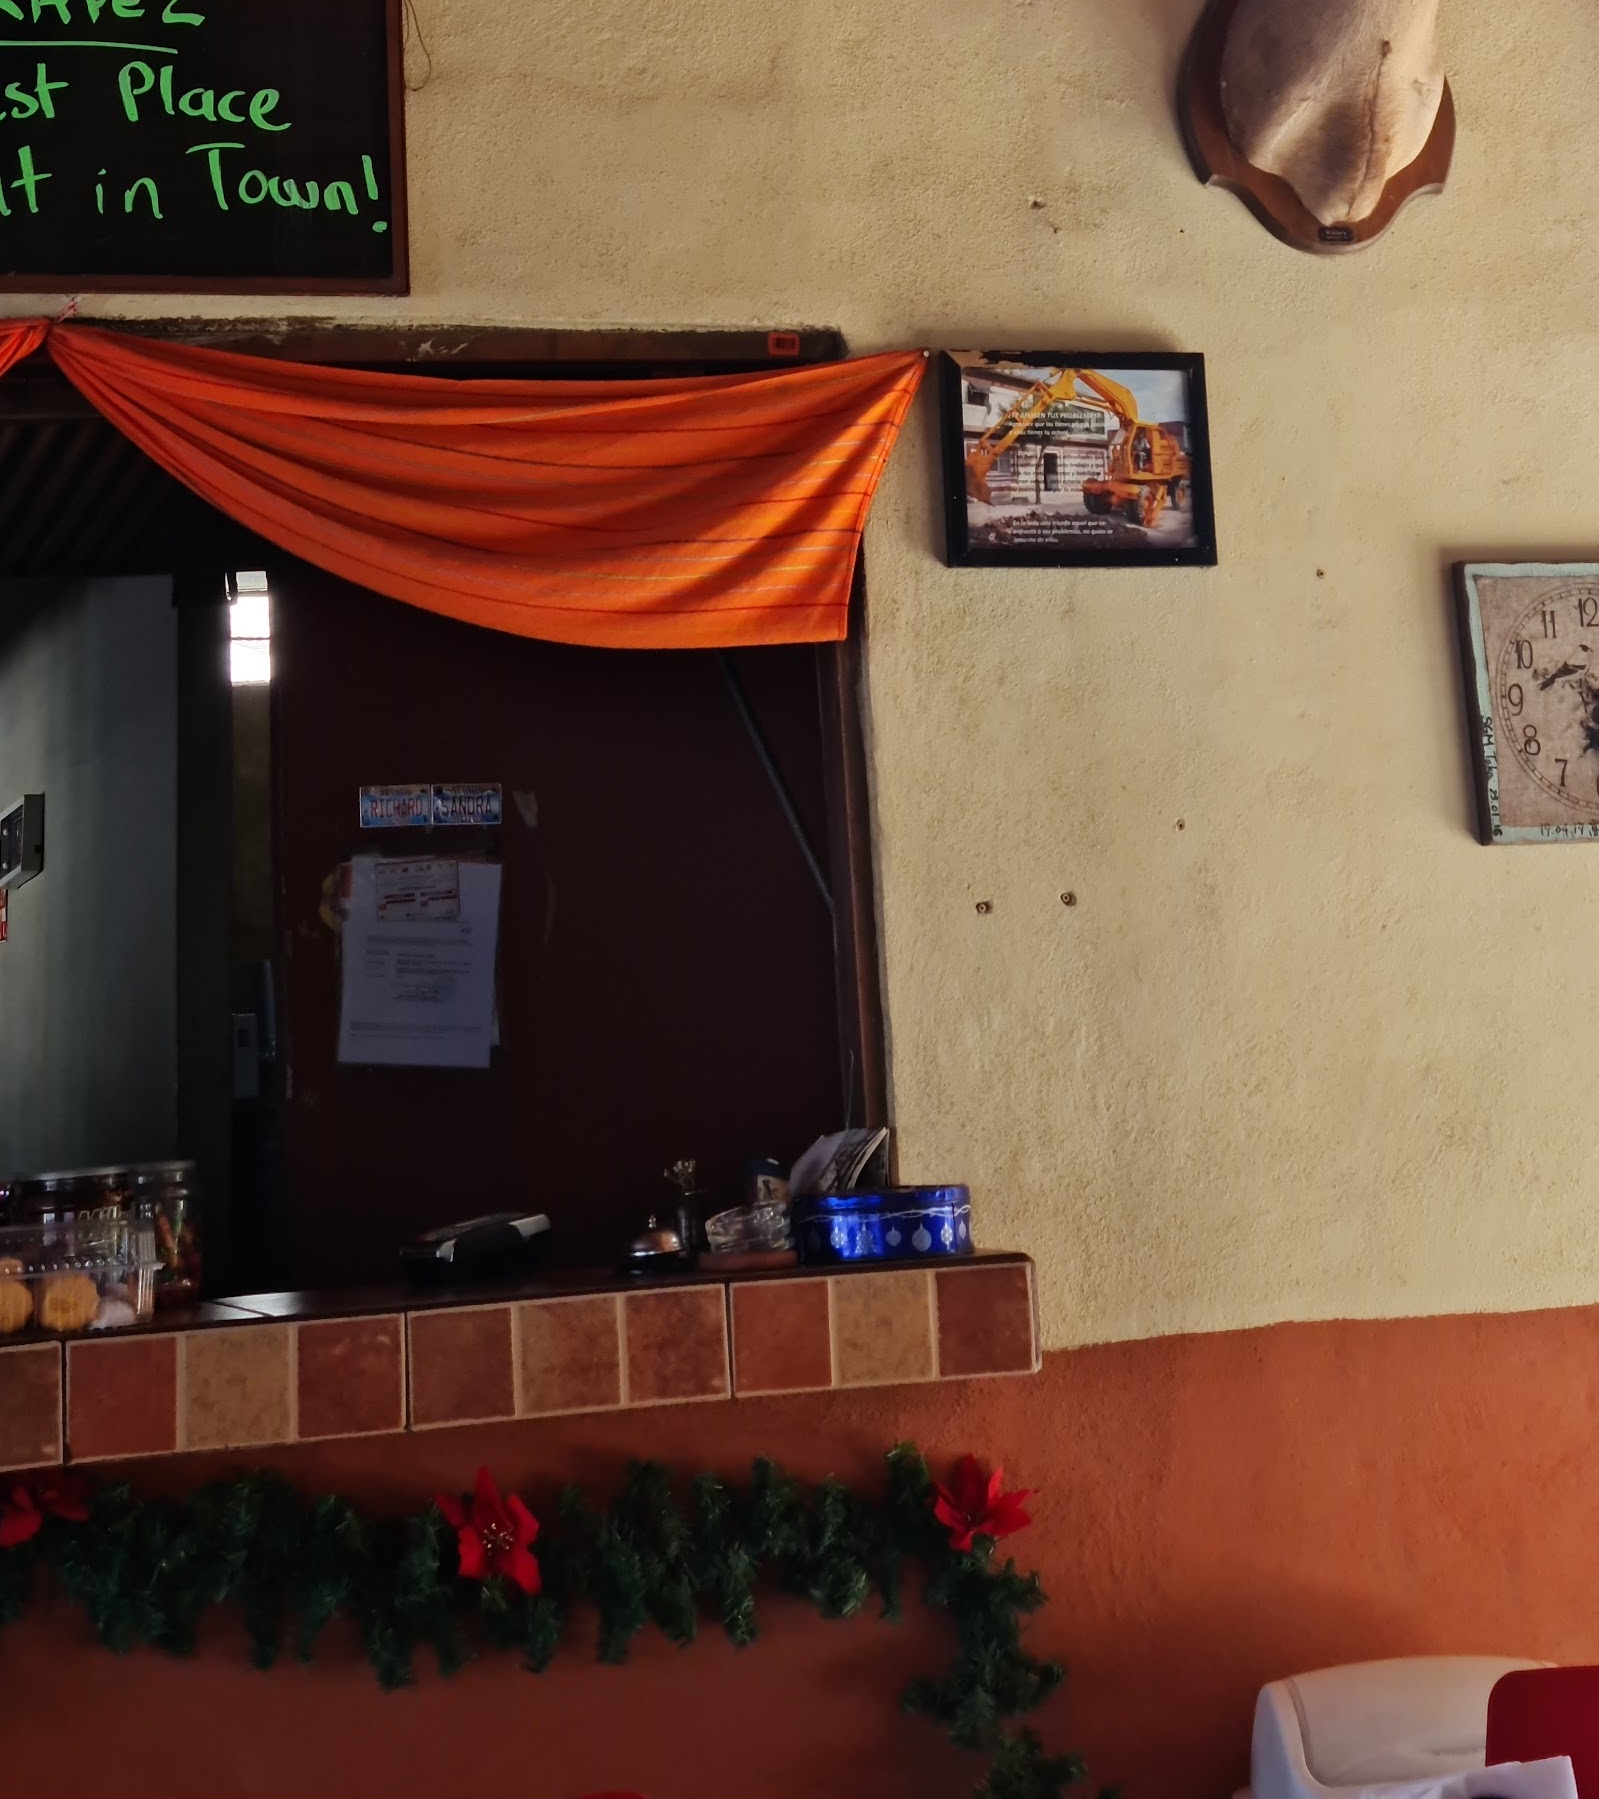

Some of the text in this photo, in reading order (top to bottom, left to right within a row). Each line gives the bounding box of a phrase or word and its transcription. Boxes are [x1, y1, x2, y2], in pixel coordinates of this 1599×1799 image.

[118, 60, 293, 132] Place
[94, 169, 164, 220] in
[186, 141, 389, 233] Town!
[1540, 609, 1558, 639] 11
[1514, 639, 1534, 670] 10
[1507, 683, 1524, 716] 9
[1523, 724, 1542, 756] 8
[1554, 757, 1569, 787] 7
[370, 799, 424, 818] RICHARD
[440, 795, 493, 816] SANDRA
